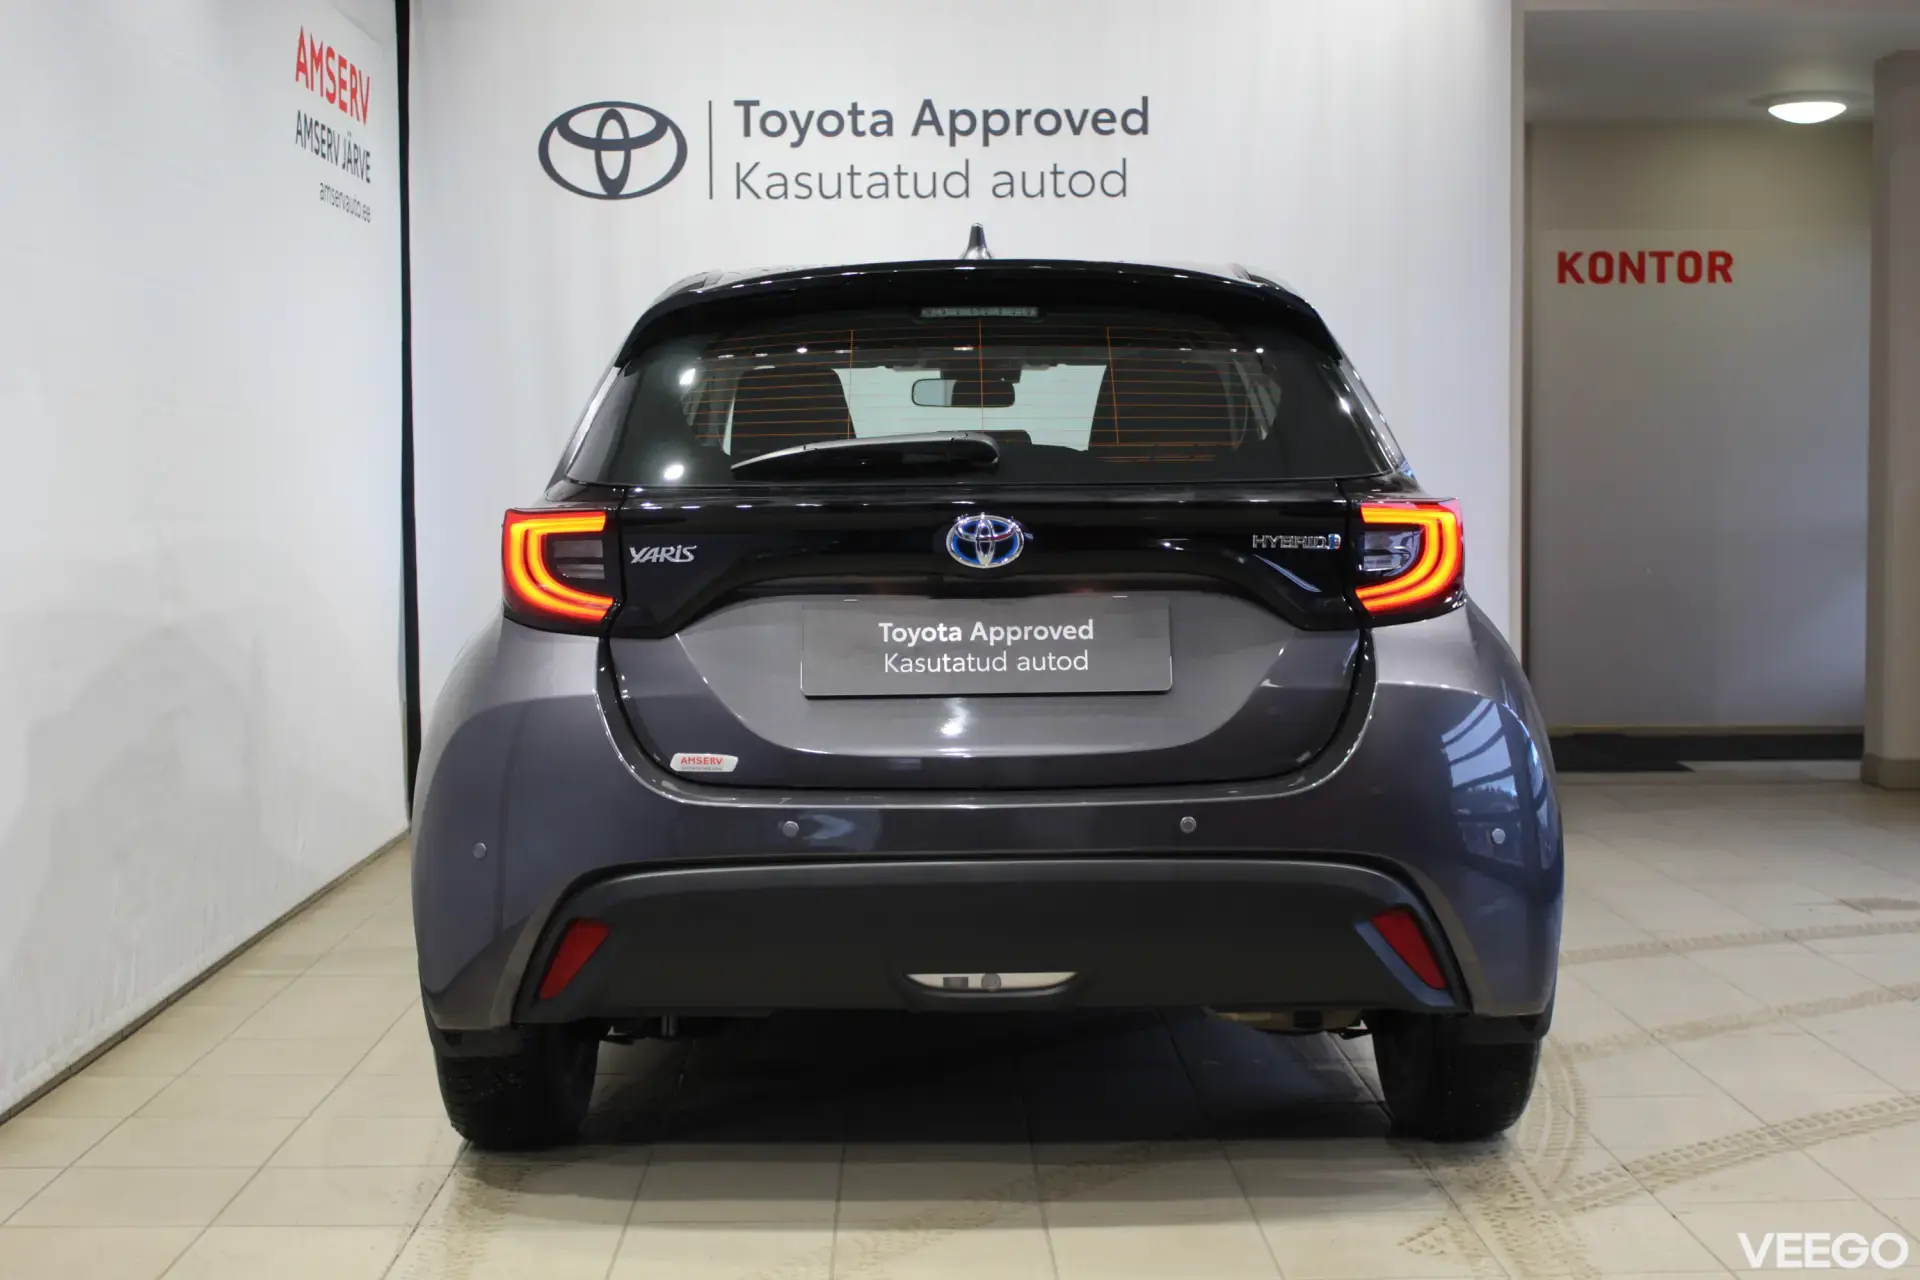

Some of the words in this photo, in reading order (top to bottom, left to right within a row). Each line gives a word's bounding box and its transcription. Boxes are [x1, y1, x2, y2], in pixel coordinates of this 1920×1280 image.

[295, 25, 370, 125] AMSERV
[733, 99, 894, 148] Toyota
[911, 96, 1150, 148] Approved
[295, 109, 340, 167] AMSERV
[341, 131, 371, 183] JÄRVE
[734, 159, 971, 200] Kasutatud
[991, 158, 1129, 199] autod
[319, 182, 371, 223] amservauto.ee
[1557, 251, 1734, 284] KONTOR
[629, 545, 698, 564] YARIS
[1252, 534, 1328, 549] HYBRID
[878, 622, 962, 647] Toyota
[969, 618, 1094, 646] Approved
[884, 650, 1007, 673] Kasutatud
[1016, 649, 1089, 671] autod
[680, 756, 723, 765] AMSERV
